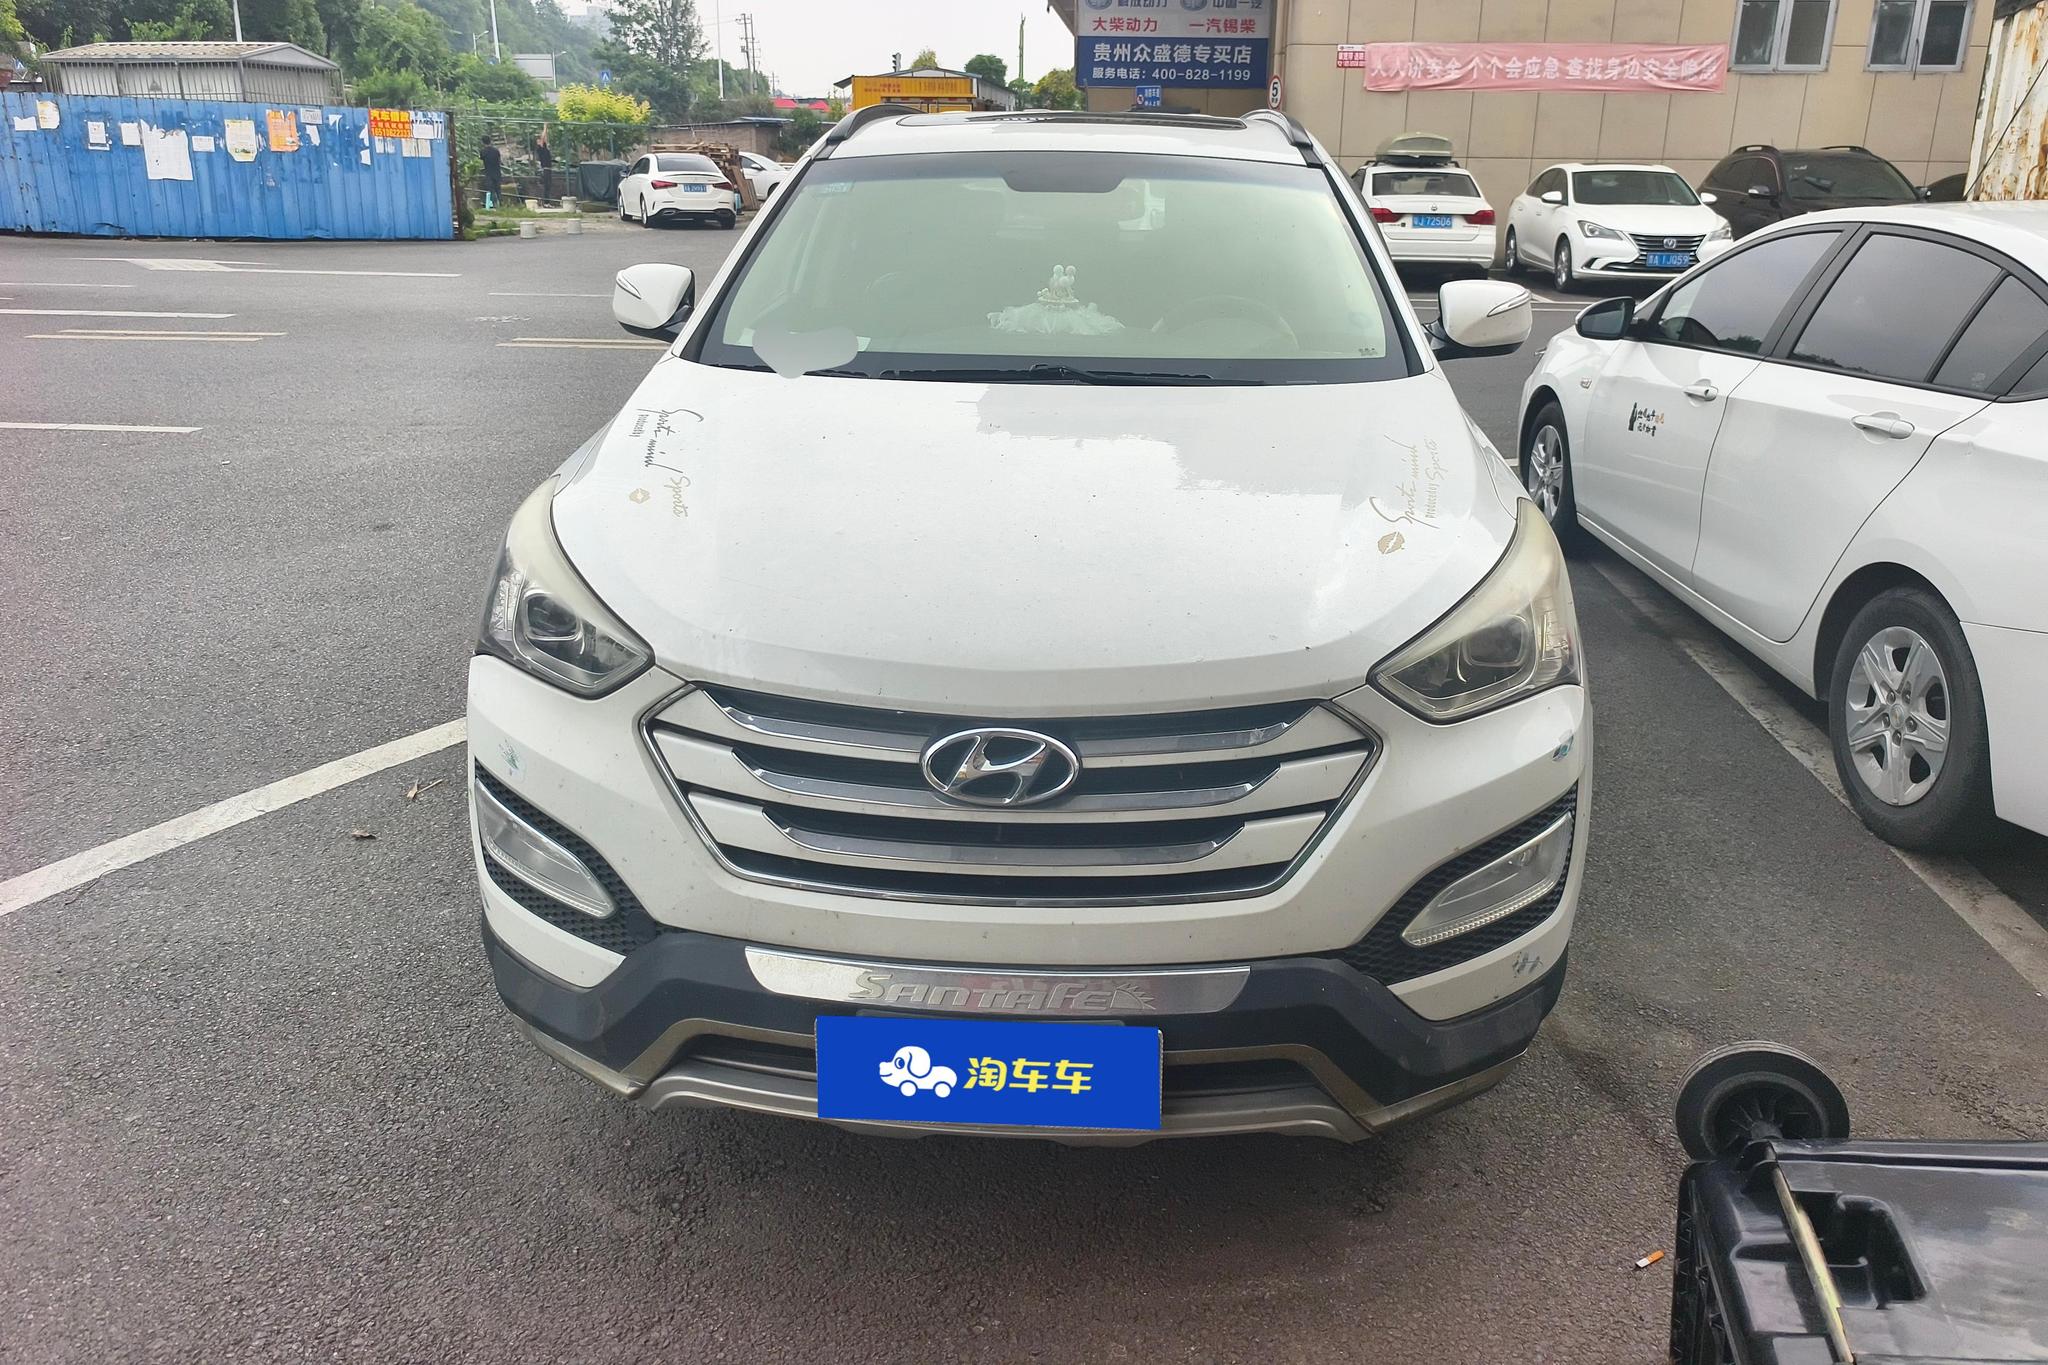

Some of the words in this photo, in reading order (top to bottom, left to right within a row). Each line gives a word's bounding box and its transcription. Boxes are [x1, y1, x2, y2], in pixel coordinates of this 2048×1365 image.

[1092, 17, 1158, 33] 大柴动力
[1189, 18, 1257, 34] 一汽锡柴
[1093, 42, 1252, 65] 贵州众盛德专买店
[1271, 81, 1279, 97] 5
